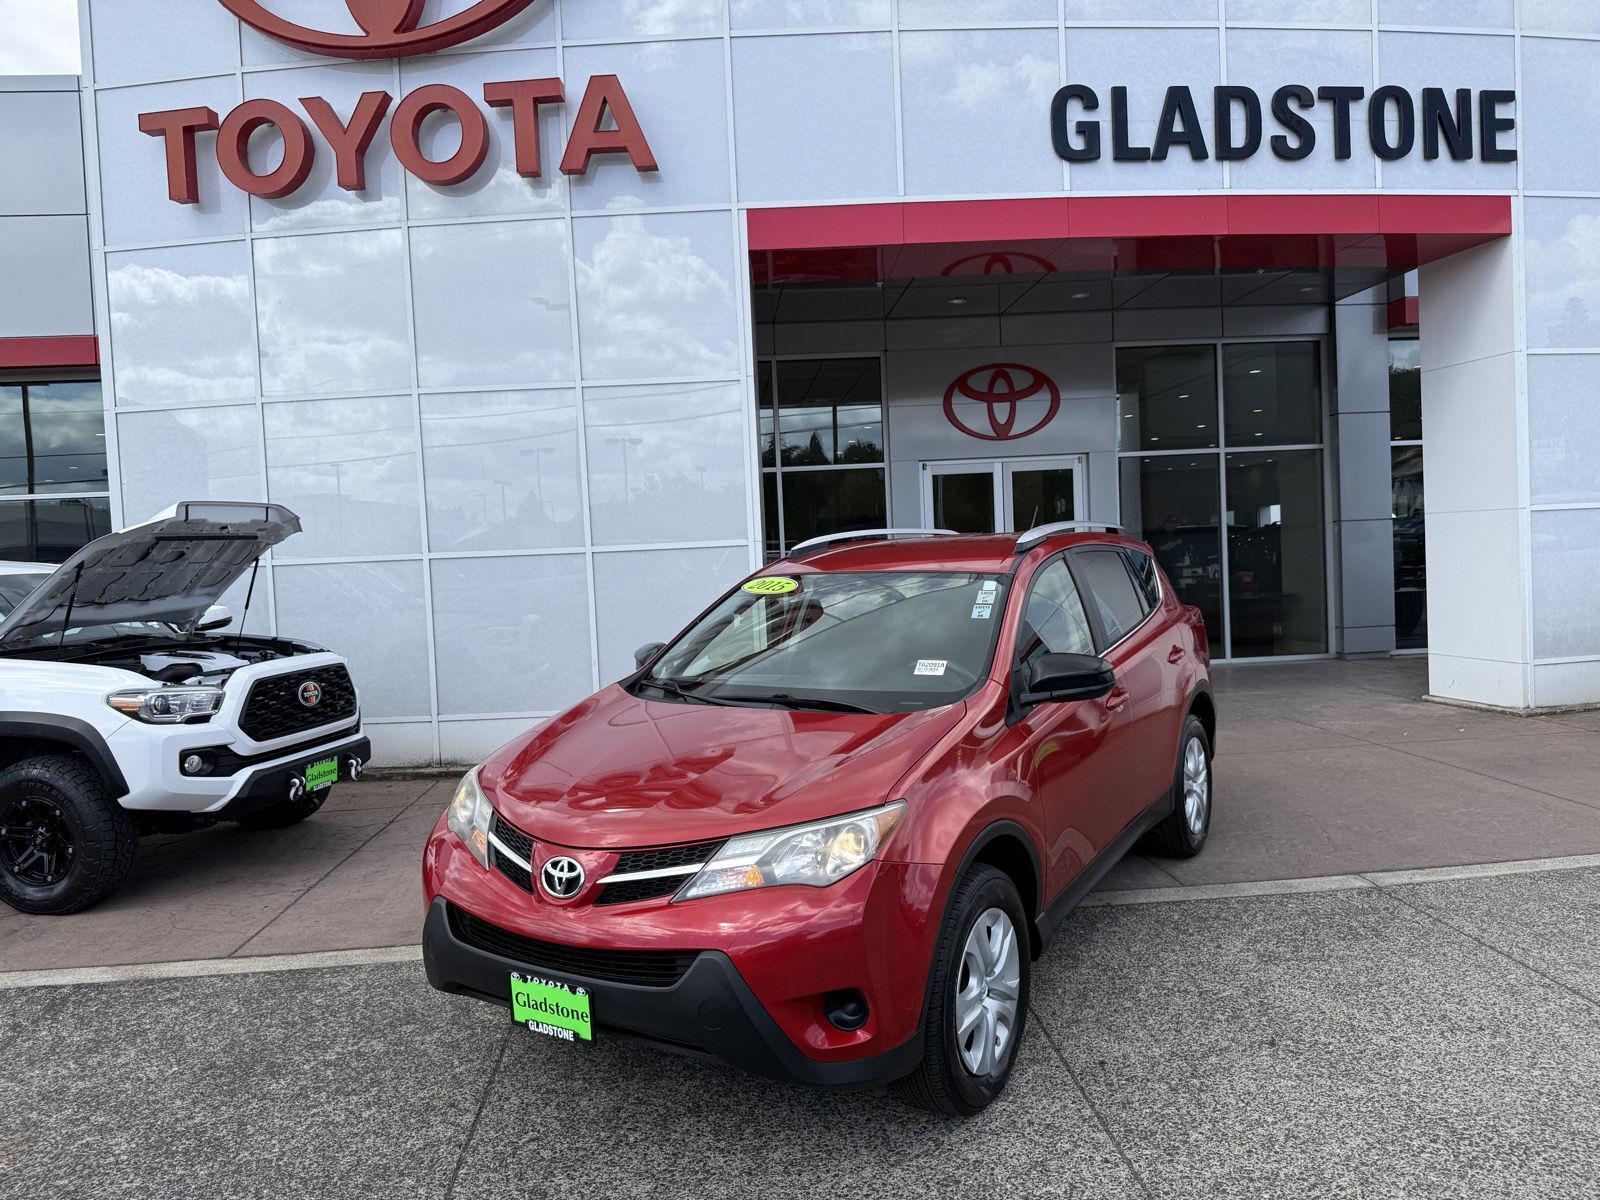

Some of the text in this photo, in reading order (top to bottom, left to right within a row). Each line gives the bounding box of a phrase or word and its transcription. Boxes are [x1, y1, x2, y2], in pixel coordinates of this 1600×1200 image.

[1050, 84, 1518, 162] GLADSTONE
[138, 74, 659, 204] TOYOTA
[746, 577, 792, 592] 2015
[306, 767, 337, 784] Gladstone
[526, 975, 570, 992] TOYOTA
[515, 991, 590, 1024] Gladstone
[528, 1020, 575, 1042] GLADSTONE
